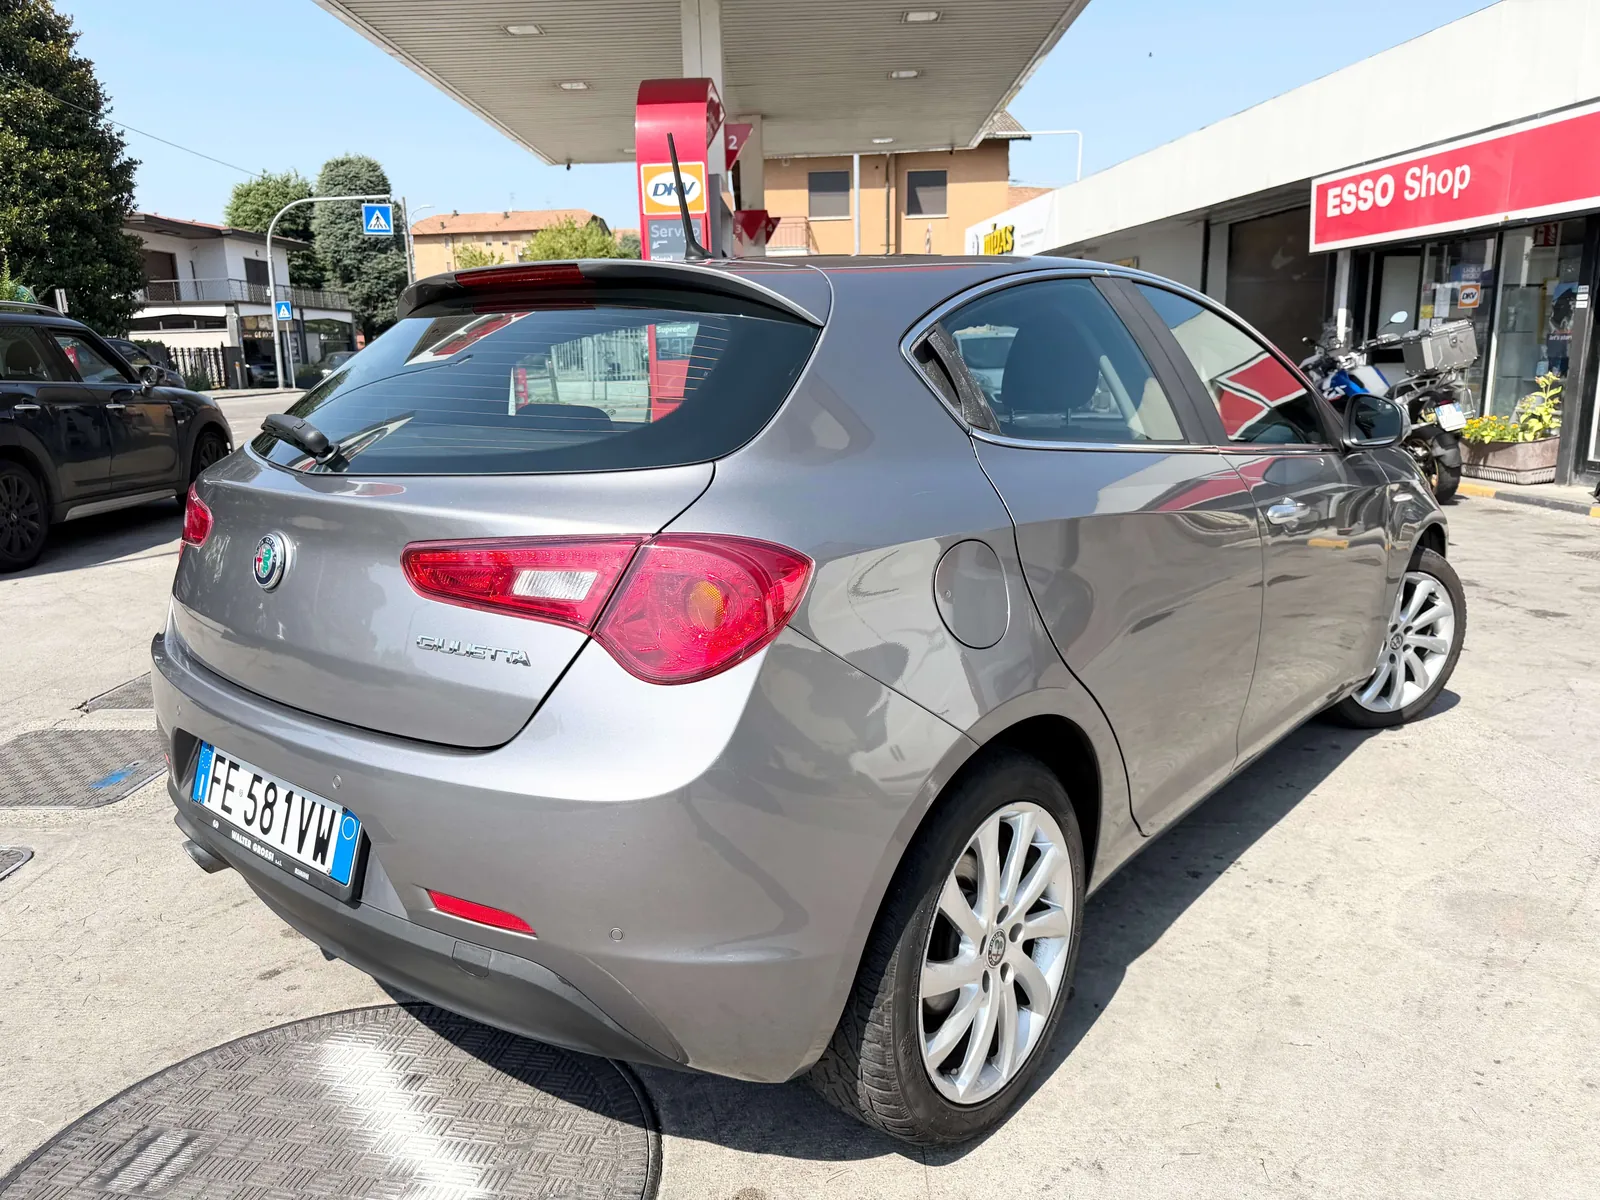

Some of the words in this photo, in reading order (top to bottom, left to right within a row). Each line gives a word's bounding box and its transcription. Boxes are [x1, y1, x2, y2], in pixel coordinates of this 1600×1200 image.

[728, 135, 738, 150] 2
[652, 181, 696, 197] DKV
[1326, 174, 1395, 218] ESSO
[1403, 164, 1471, 201] Shop
[416, 634, 532, 667] GIULIETTA
[208, 754, 241, 815] FE
[243, 774, 337, 866] 581VW
